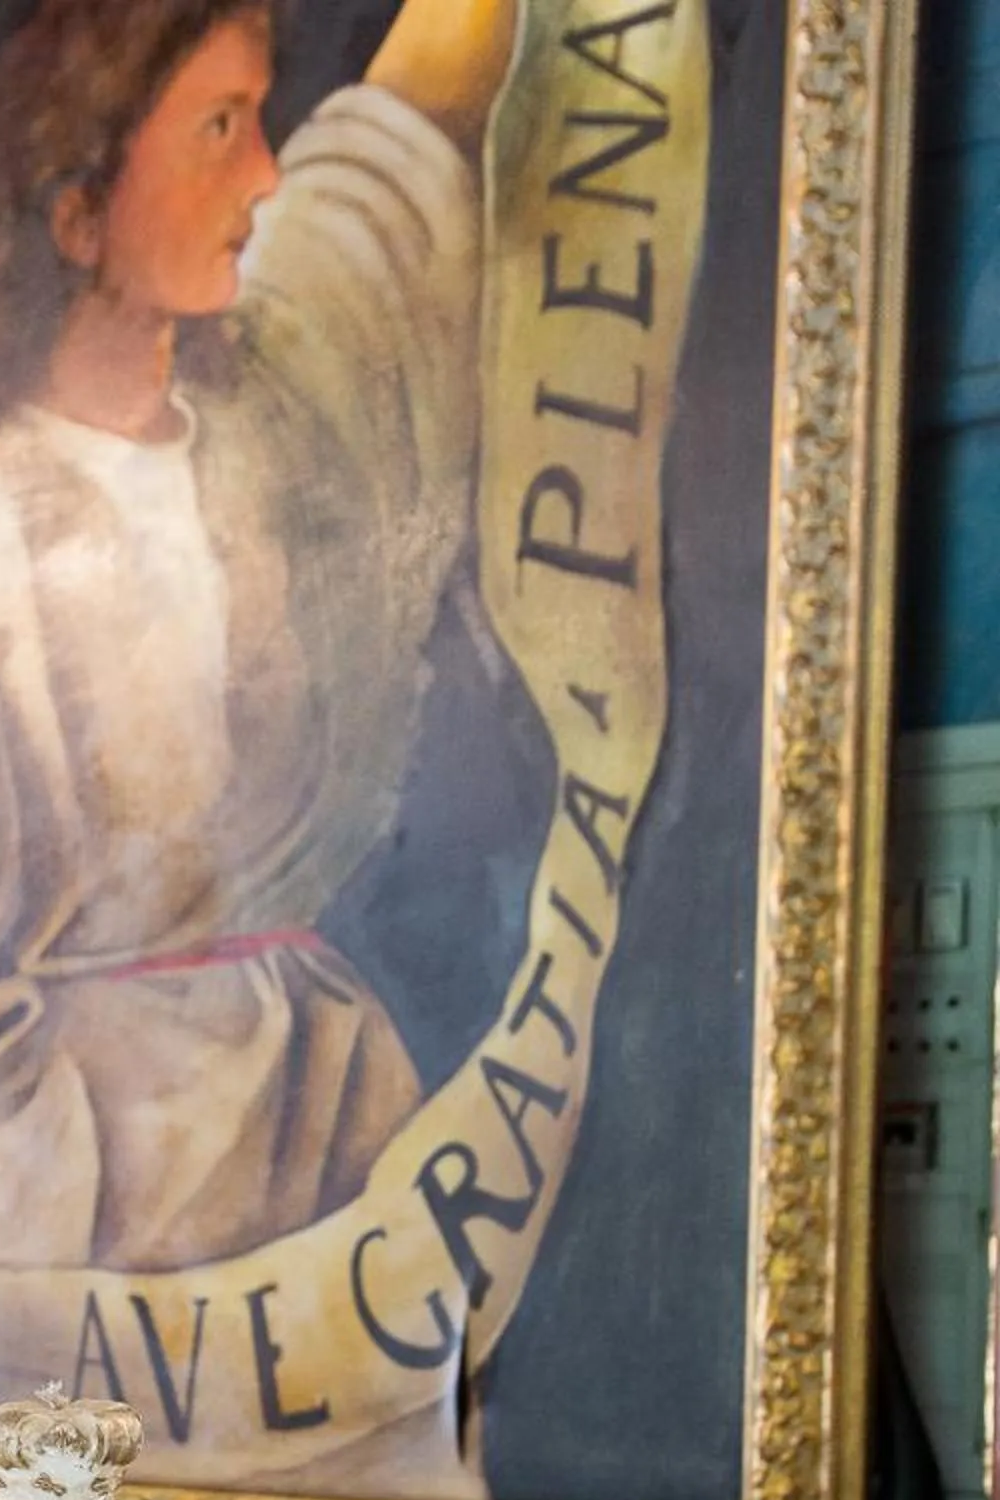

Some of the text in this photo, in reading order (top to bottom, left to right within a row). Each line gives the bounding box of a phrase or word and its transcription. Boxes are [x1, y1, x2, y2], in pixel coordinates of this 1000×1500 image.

[72, 2, 676, 1445] AVE GRATIA PLENA
